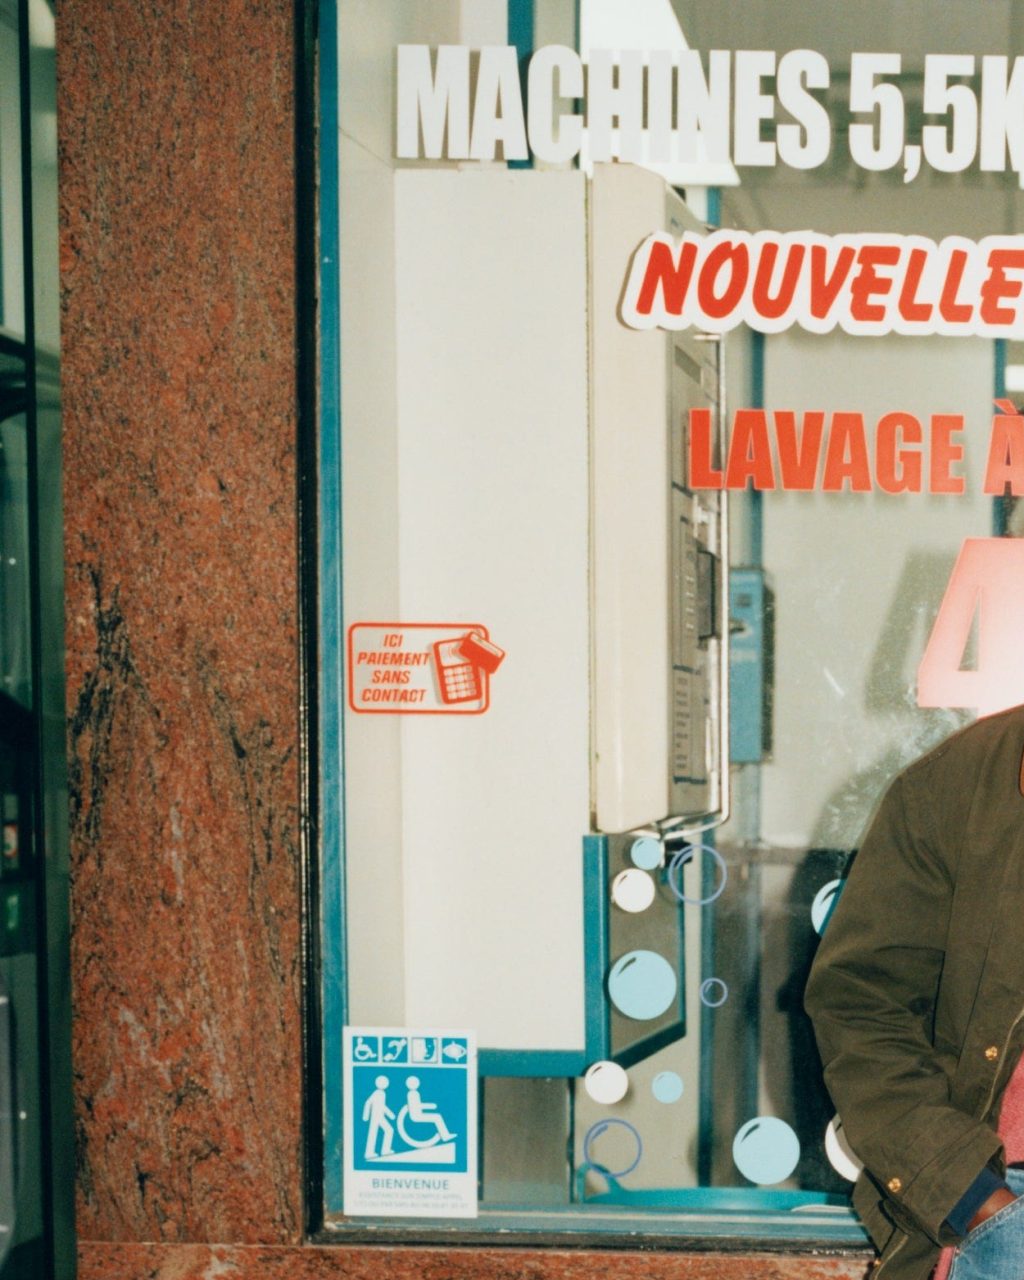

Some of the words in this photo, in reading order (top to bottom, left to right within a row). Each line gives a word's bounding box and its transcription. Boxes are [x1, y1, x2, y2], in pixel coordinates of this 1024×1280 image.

[395, 44, 832, 169] MACHINES
[687, 407, 965, 495] LAVAGE
[383, 634, 404, 648] ICI
[356, 651, 431, 666] PAIEMENT
[371, 670, 411, 684] SANS
[361, 688, 427, 703] CONTACT
[371, 1178, 450, 1190] BIENVENUE
